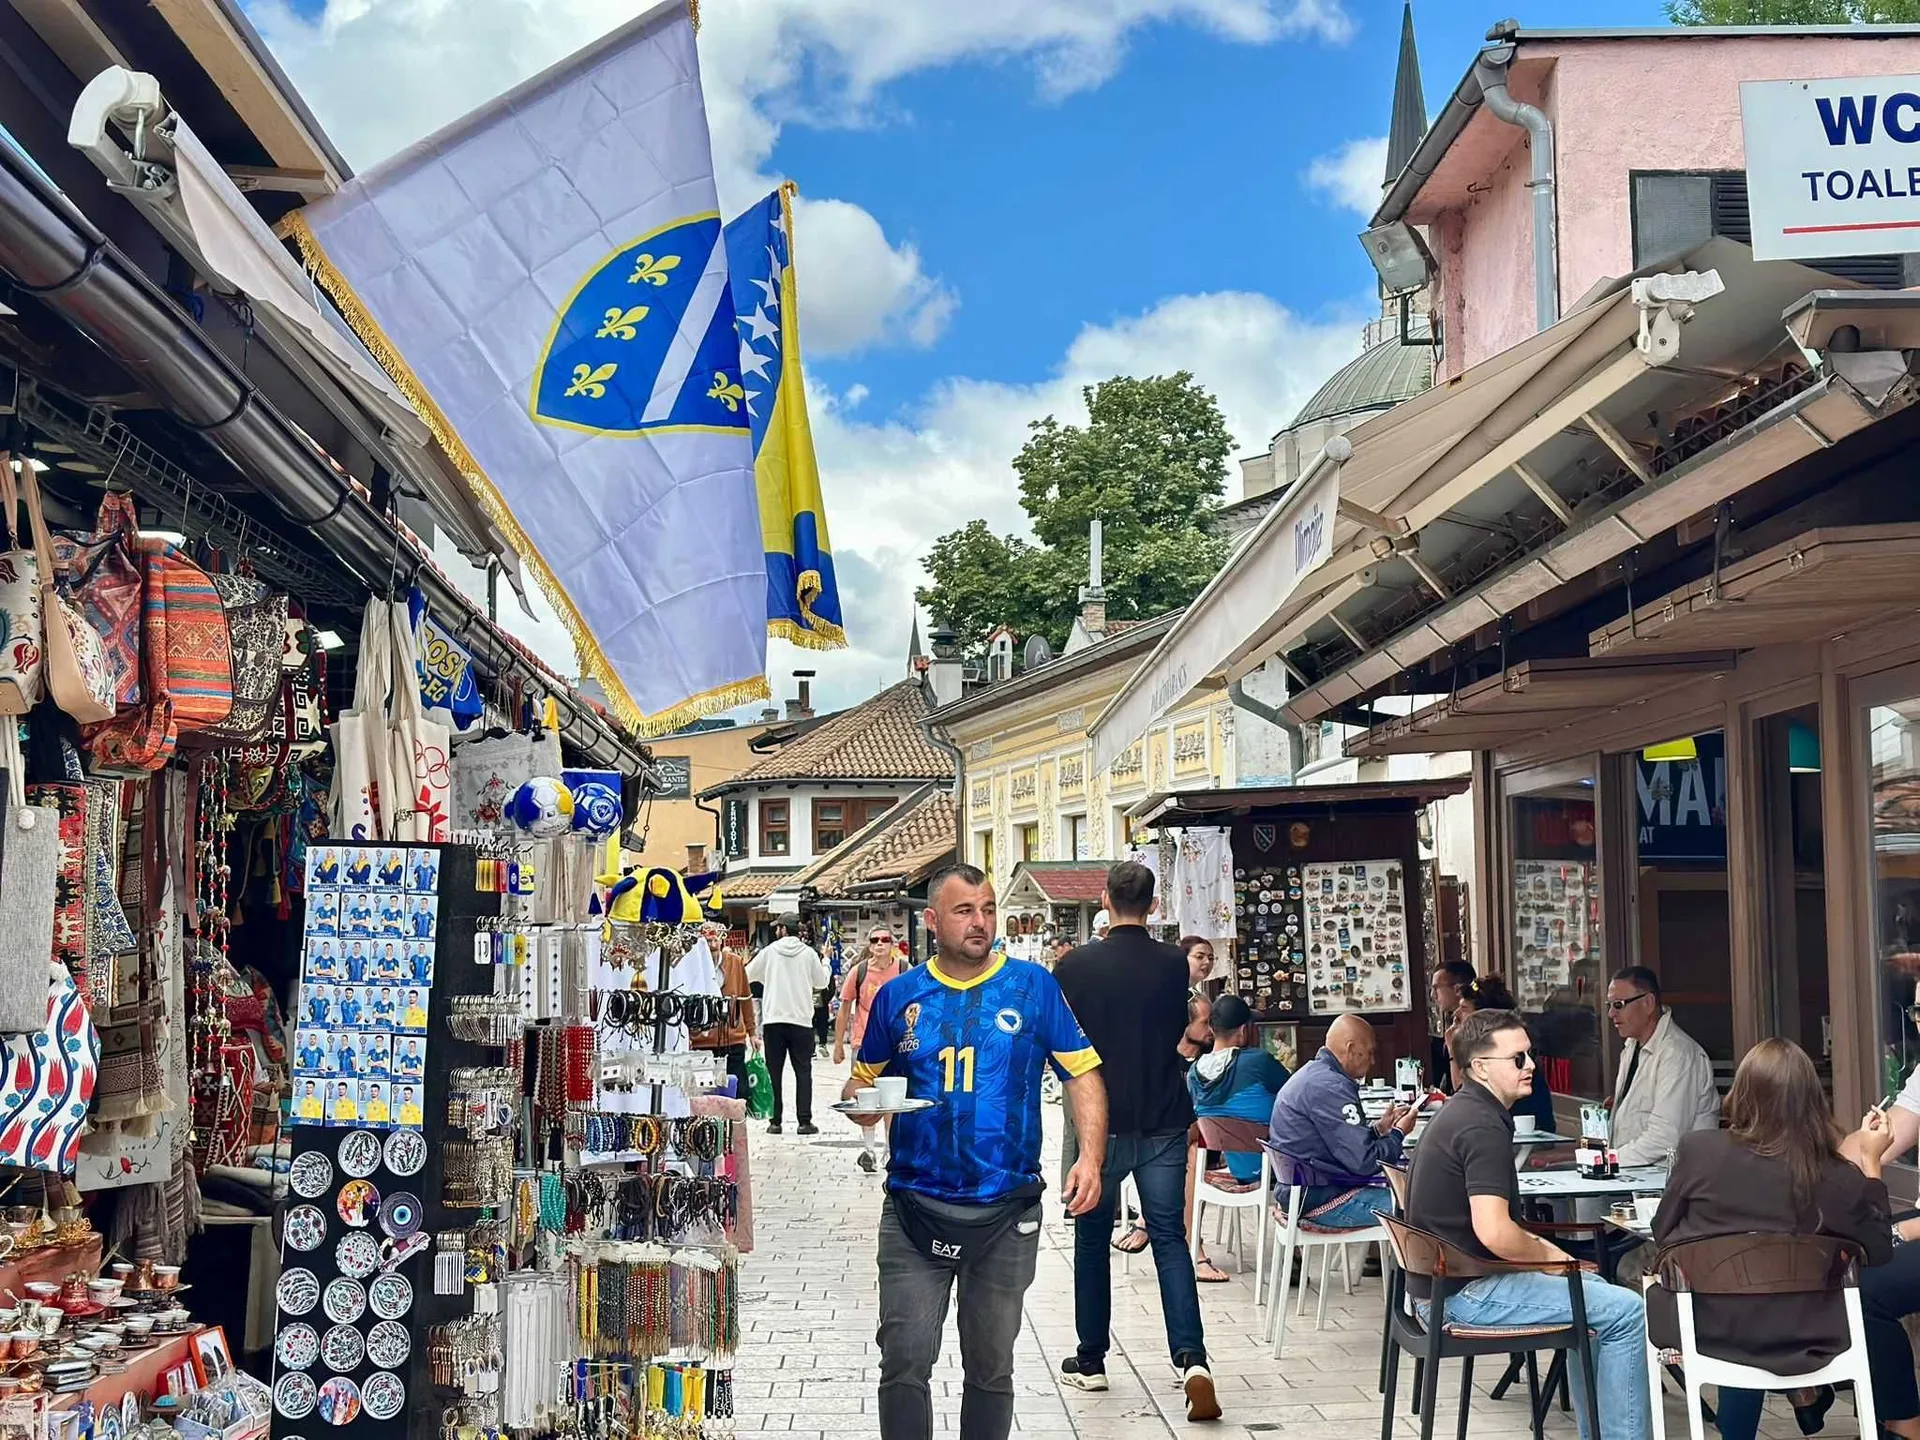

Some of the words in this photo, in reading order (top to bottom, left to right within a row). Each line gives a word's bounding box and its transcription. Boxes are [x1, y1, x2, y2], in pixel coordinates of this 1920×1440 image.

[1814, 92, 1920, 146] WC
[898, 1038, 921, 1054] 2026
[938, 1046, 975, 1093] 11
[1341, 1103, 1361, 1126] 3
[932, 1239, 962, 1257] EA7
